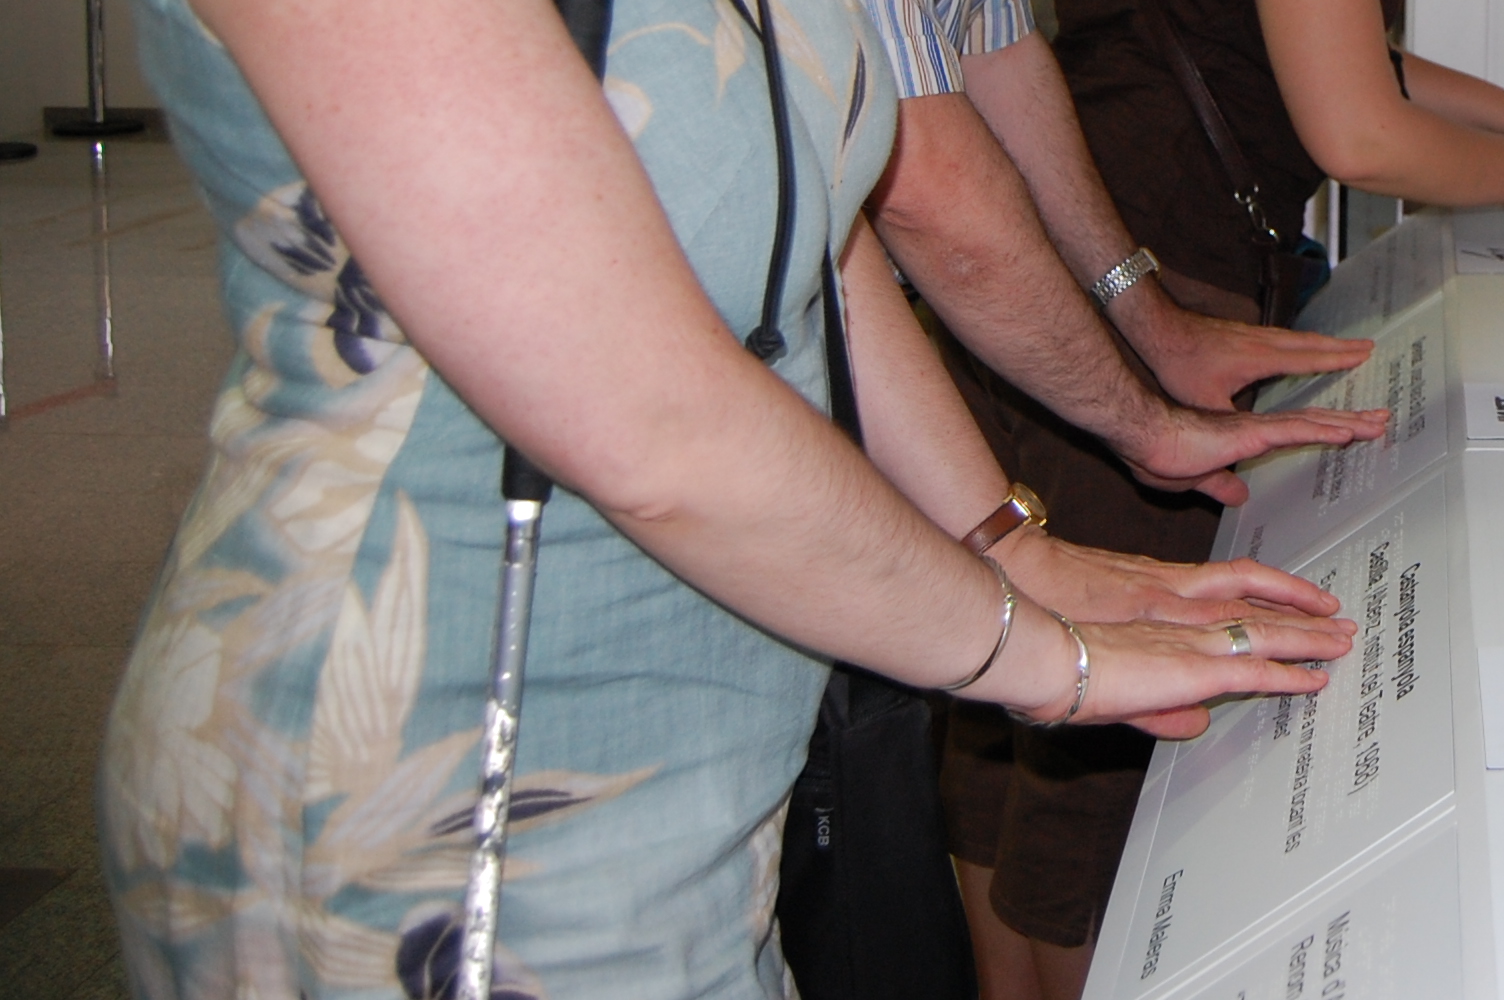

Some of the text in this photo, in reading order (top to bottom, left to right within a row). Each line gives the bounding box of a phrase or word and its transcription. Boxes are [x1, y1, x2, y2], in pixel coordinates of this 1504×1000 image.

[1361, 672, 1384, 699] del
[1391, 628, 1420, 701] espanyola
[1353, 689, 1384, 749] Teatre,
[817, 815, 830, 847] KCB
[1140, 869, 1184, 981] Emma Maleras
[1323, 910, 1350, 979] Música
